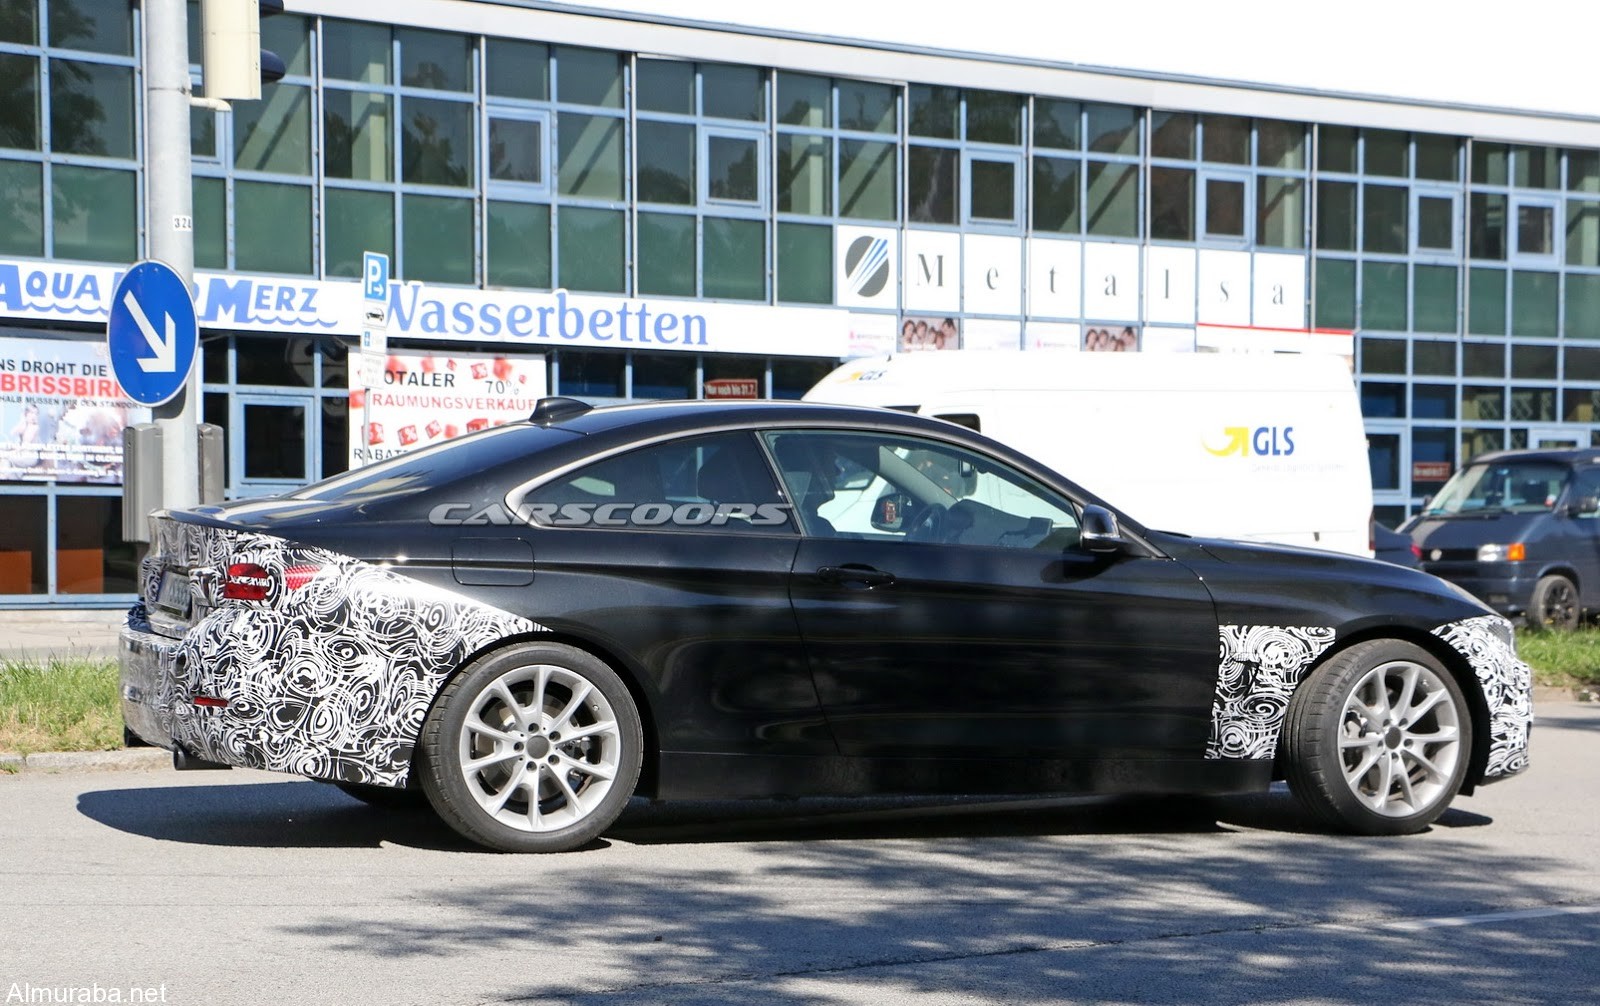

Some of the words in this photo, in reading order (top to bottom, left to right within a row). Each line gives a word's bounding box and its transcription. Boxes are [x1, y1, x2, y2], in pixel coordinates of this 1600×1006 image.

[367, 258, 382, 295] P
[917, 253, 1284, 304] Metalsa
[198, 277, 319, 324] MERZ
[386, 283, 709, 345] Wasserbetten
[22, 360, 76, 375] DROHT
[82, 364, 108, 377] DIE
[384, 368, 456, 388] OTALER
[484, 379, 520, 396] 70%
[1253, 426, 1295, 456] GLS
